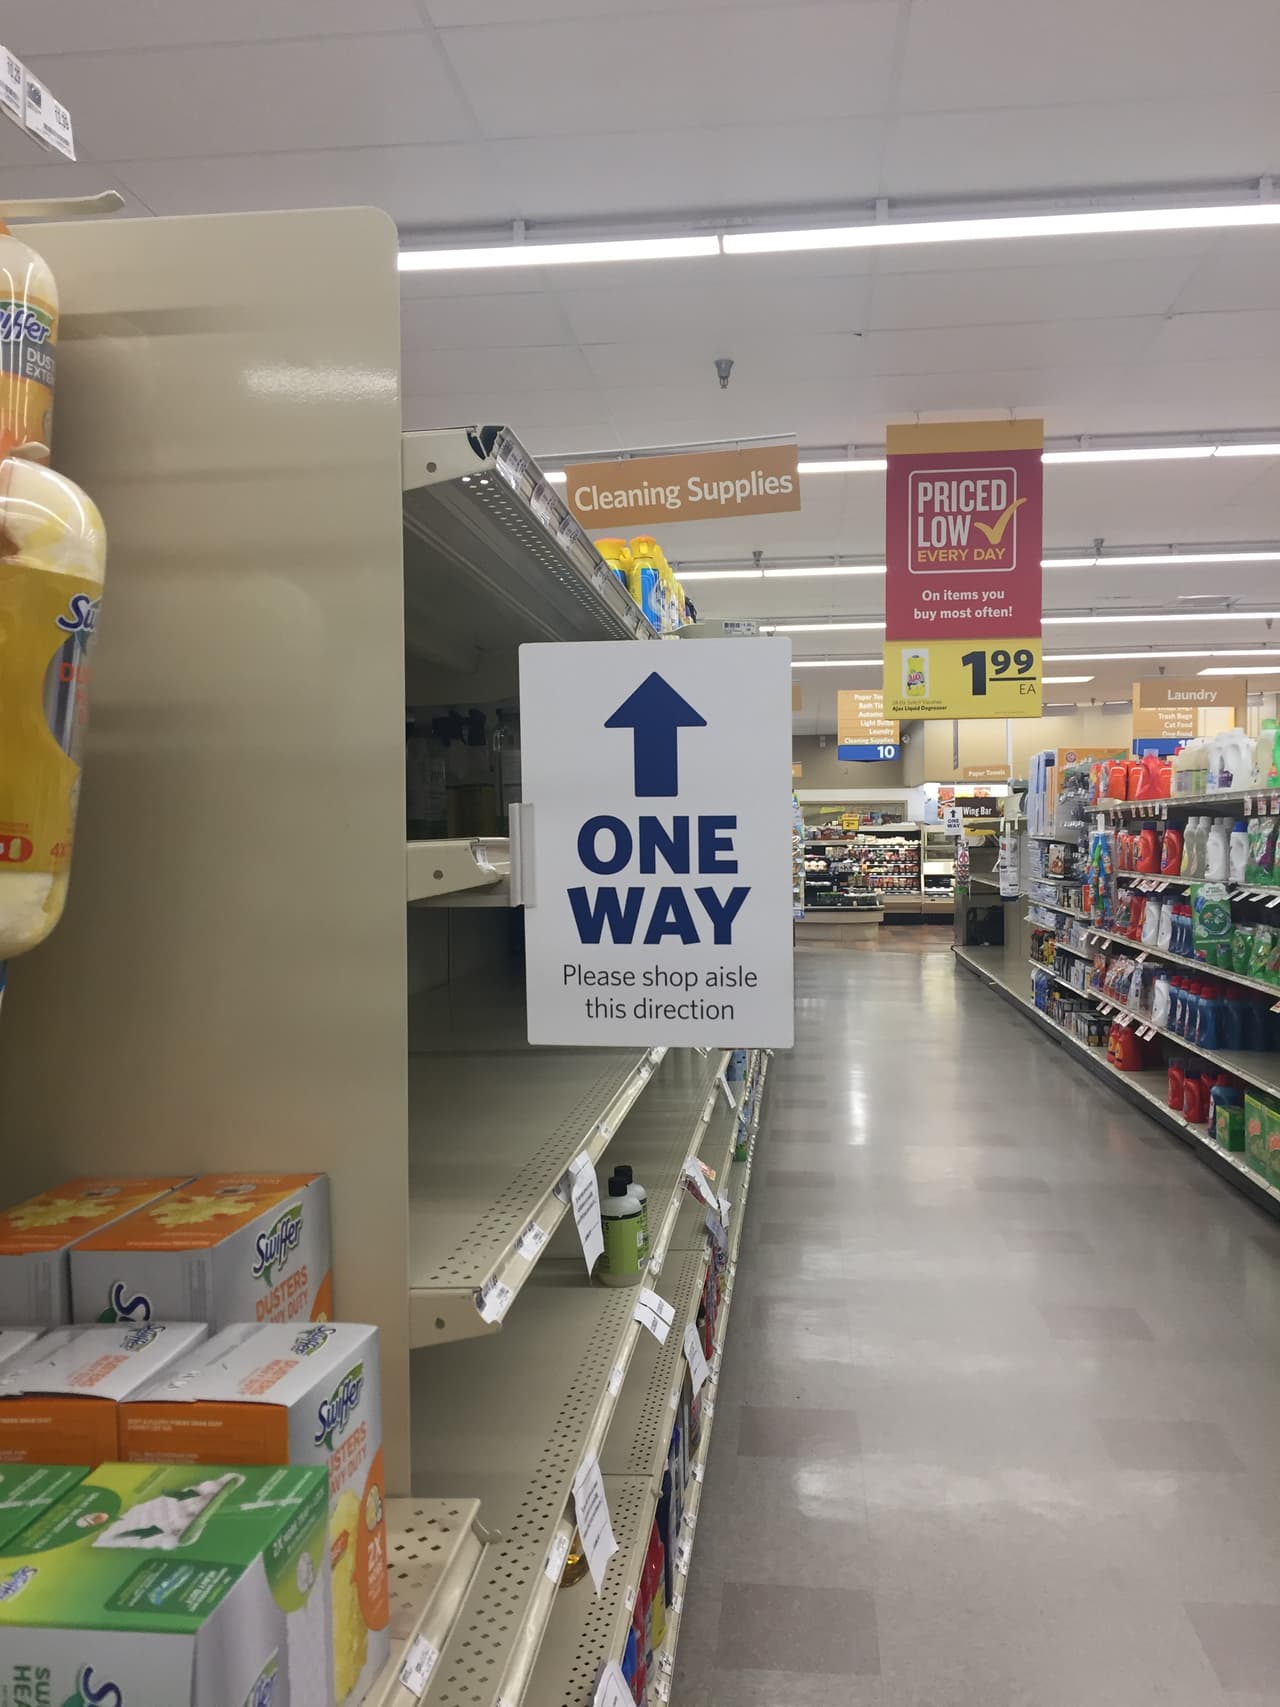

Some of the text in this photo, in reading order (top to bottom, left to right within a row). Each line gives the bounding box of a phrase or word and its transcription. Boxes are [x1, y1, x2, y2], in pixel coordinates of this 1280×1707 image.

[574, 470, 793, 511] Cleaning Supplies
[918, 479, 1007, 513] PRICED
[917, 514, 971, 548] LOW
[917, 548, 1006, 563] EVERY DAY
[921, 589, 1005, 602] On items you
[914, 606, 1013, 621] buy most often!
[1019, 683, 1036, 695] EA
[1167, 689, 1217, 702] Laundry
[1177, 712, 1193, 720] Bags
[860, 720, 876, 728] Light
[844, 737, 869, 745] Cleaning
[877, 746, 895, 759] 10
[968, 770, 985, 778] Paper
[963, 806, 992, 817] Wing Bar
[577, 815, 738, 875] ONE
[567, 886, 752, 945] WAY
[563, 964, 758, 991] Please shop aisle
[585, 997, 735, 1020] this direction
[253, 1217, 302, 1274] Swiffer
[256, 1264, 308, 1323] DUSTERS
[314, 1376, 364, 1442] Swiffer
